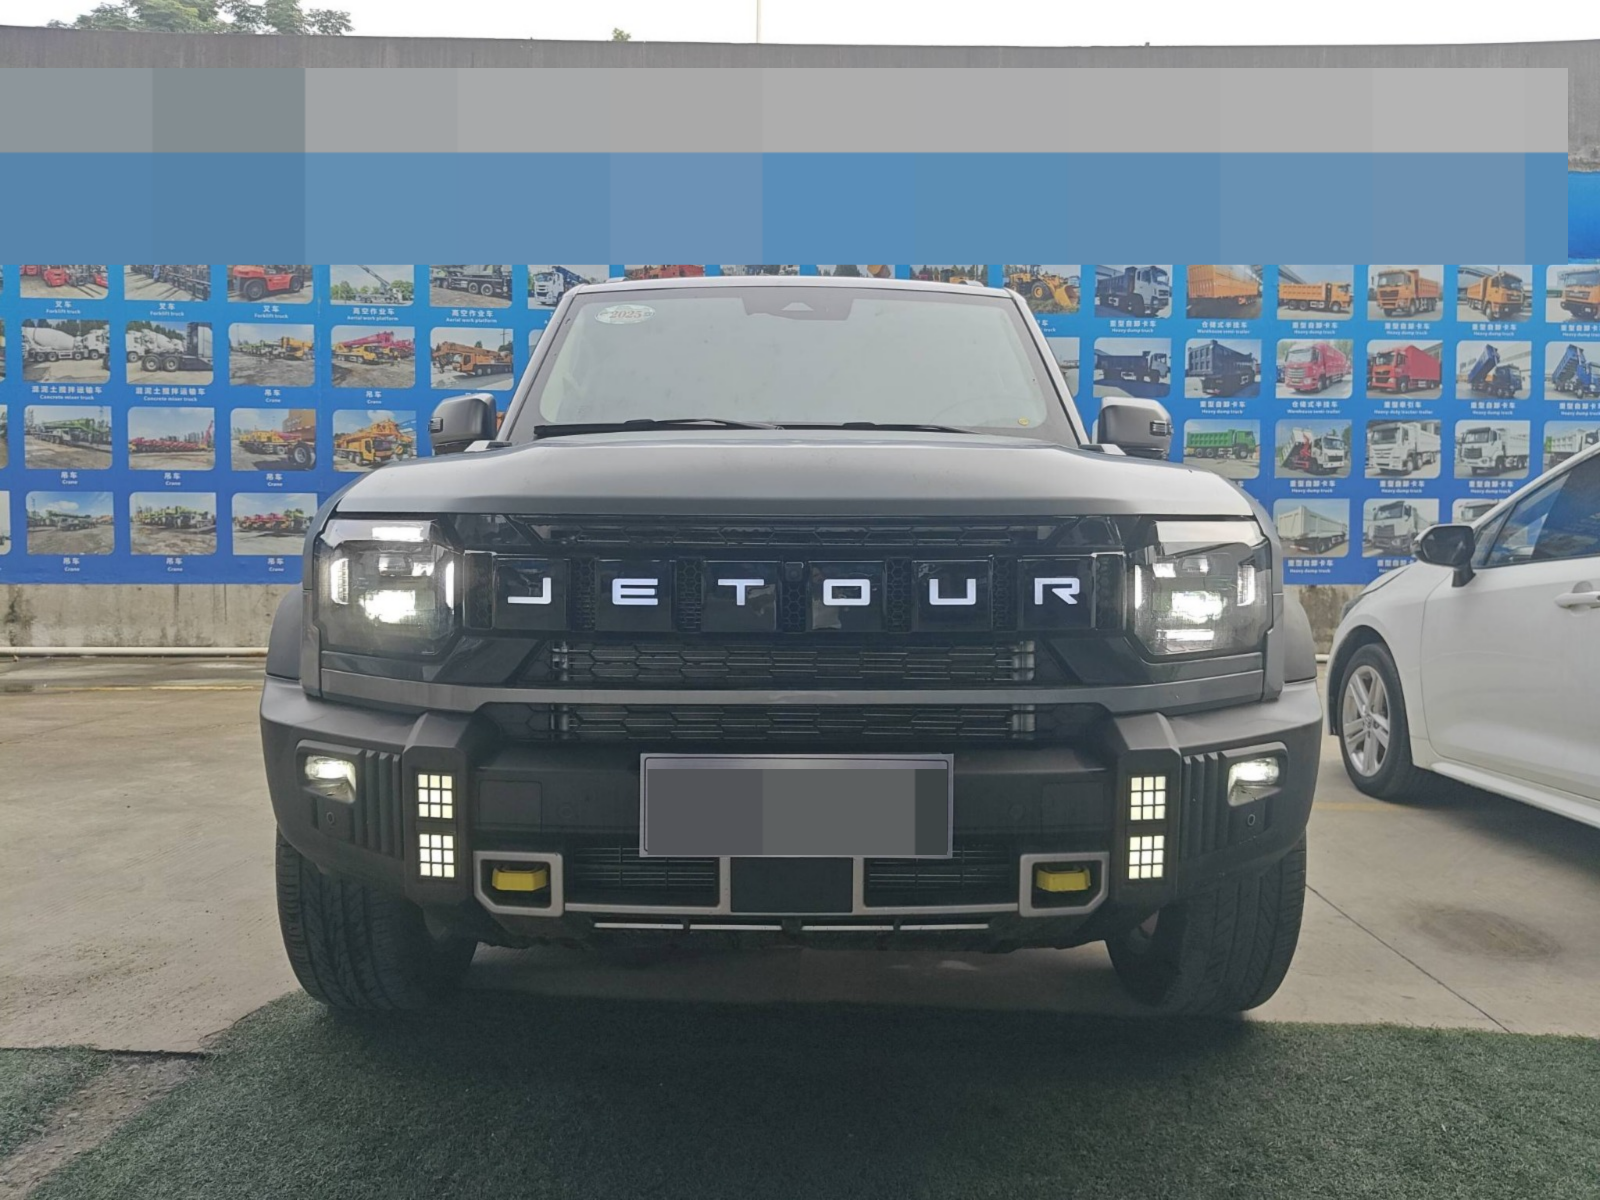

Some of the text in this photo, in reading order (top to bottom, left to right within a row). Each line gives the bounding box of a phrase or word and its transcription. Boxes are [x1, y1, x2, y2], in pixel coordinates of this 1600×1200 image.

[55, 300, 72, 308] 叉车
[263, 305, 280, 313] 叉车
[451, 309, 494, 317] 高空作业车
[610, 310, 642, 318] 2025
[507, 577, 1080, 606] JETOUR
